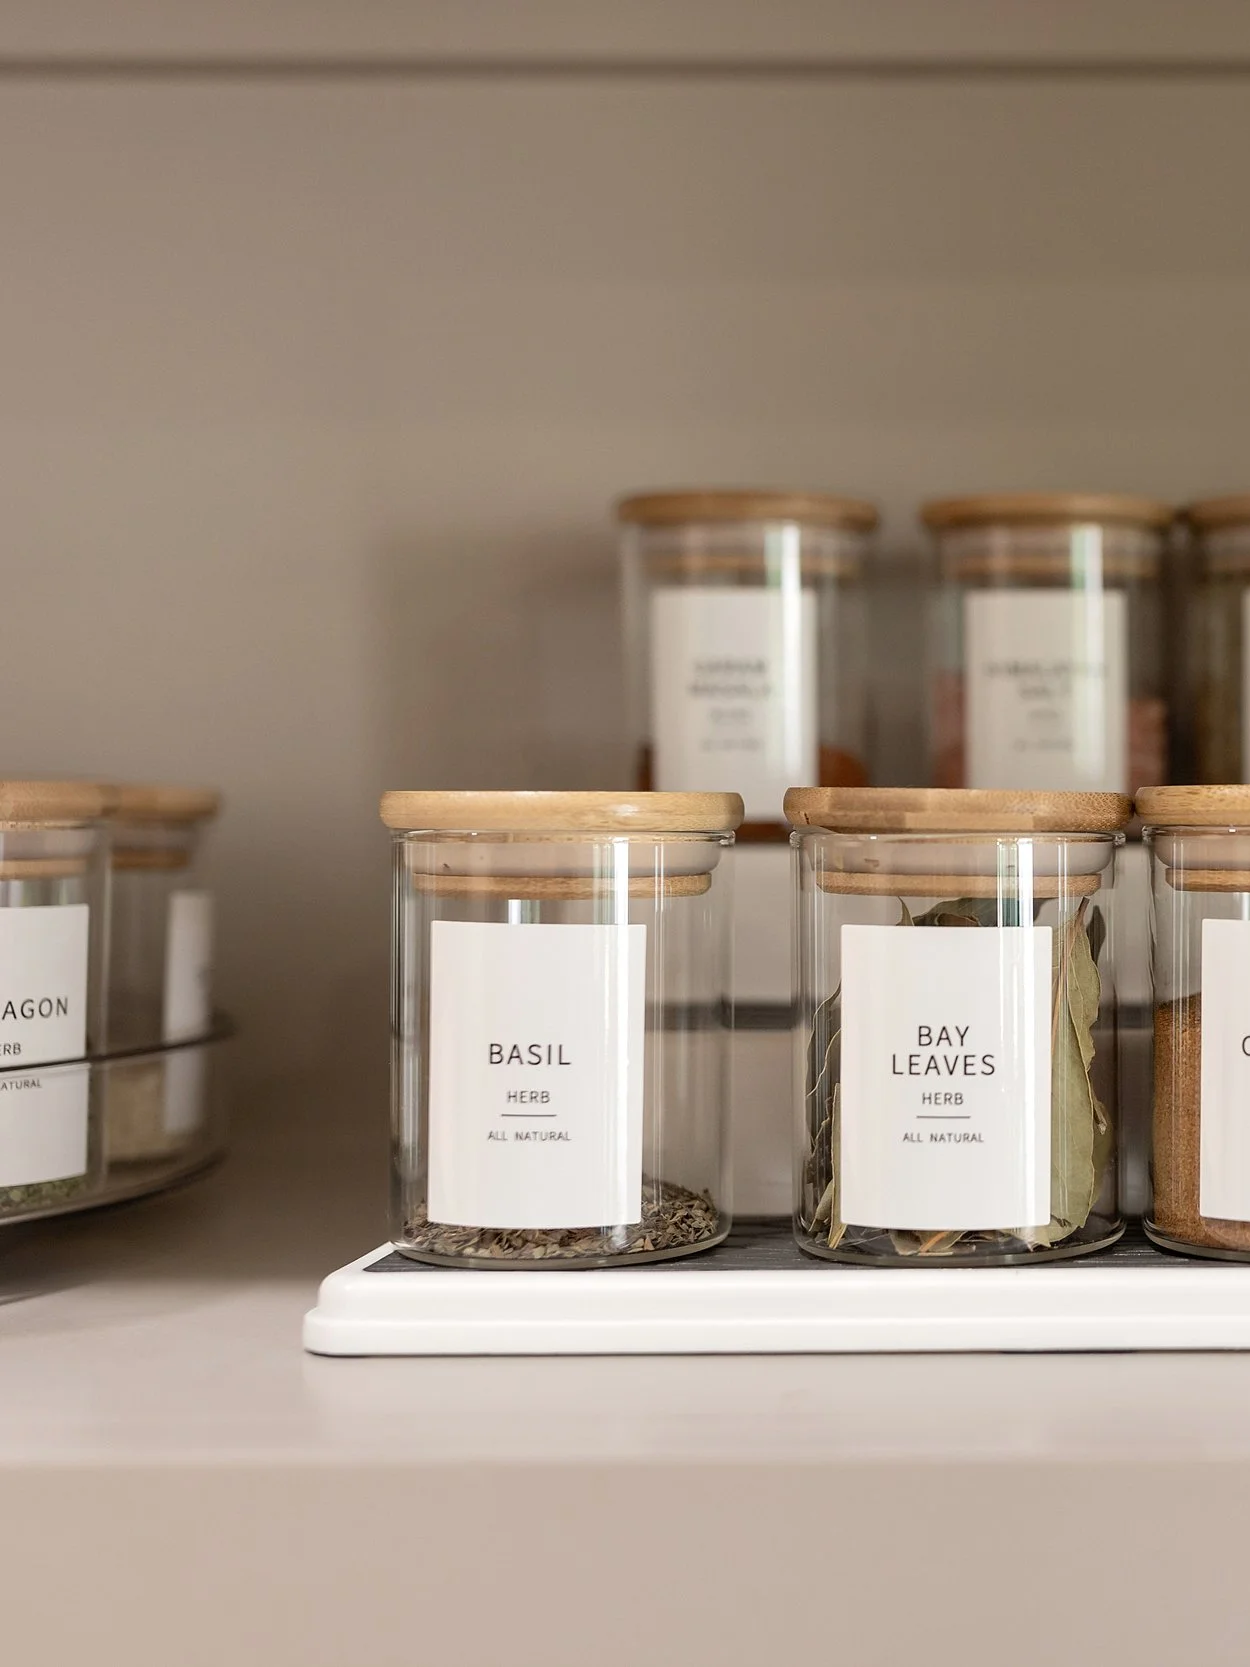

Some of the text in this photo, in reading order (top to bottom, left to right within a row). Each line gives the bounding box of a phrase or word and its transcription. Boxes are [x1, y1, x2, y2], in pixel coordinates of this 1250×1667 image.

[918, 1025, 969, 1047] BAY
[0, 1042, 22, 1056] RB
[488, 1043, 572, 1066] BASIL
[892, 1053, 995, 1076] LEAVES
[0, 1079, 42, 1091] ATURAL
[506, 1090, 551, 1104] HERB
[921, 1092, 964, 1105] HERB
[487, 1130, 572, 1142] ALL NATURAL
[902, 1132, 984, 1143] ALL NATURAL
